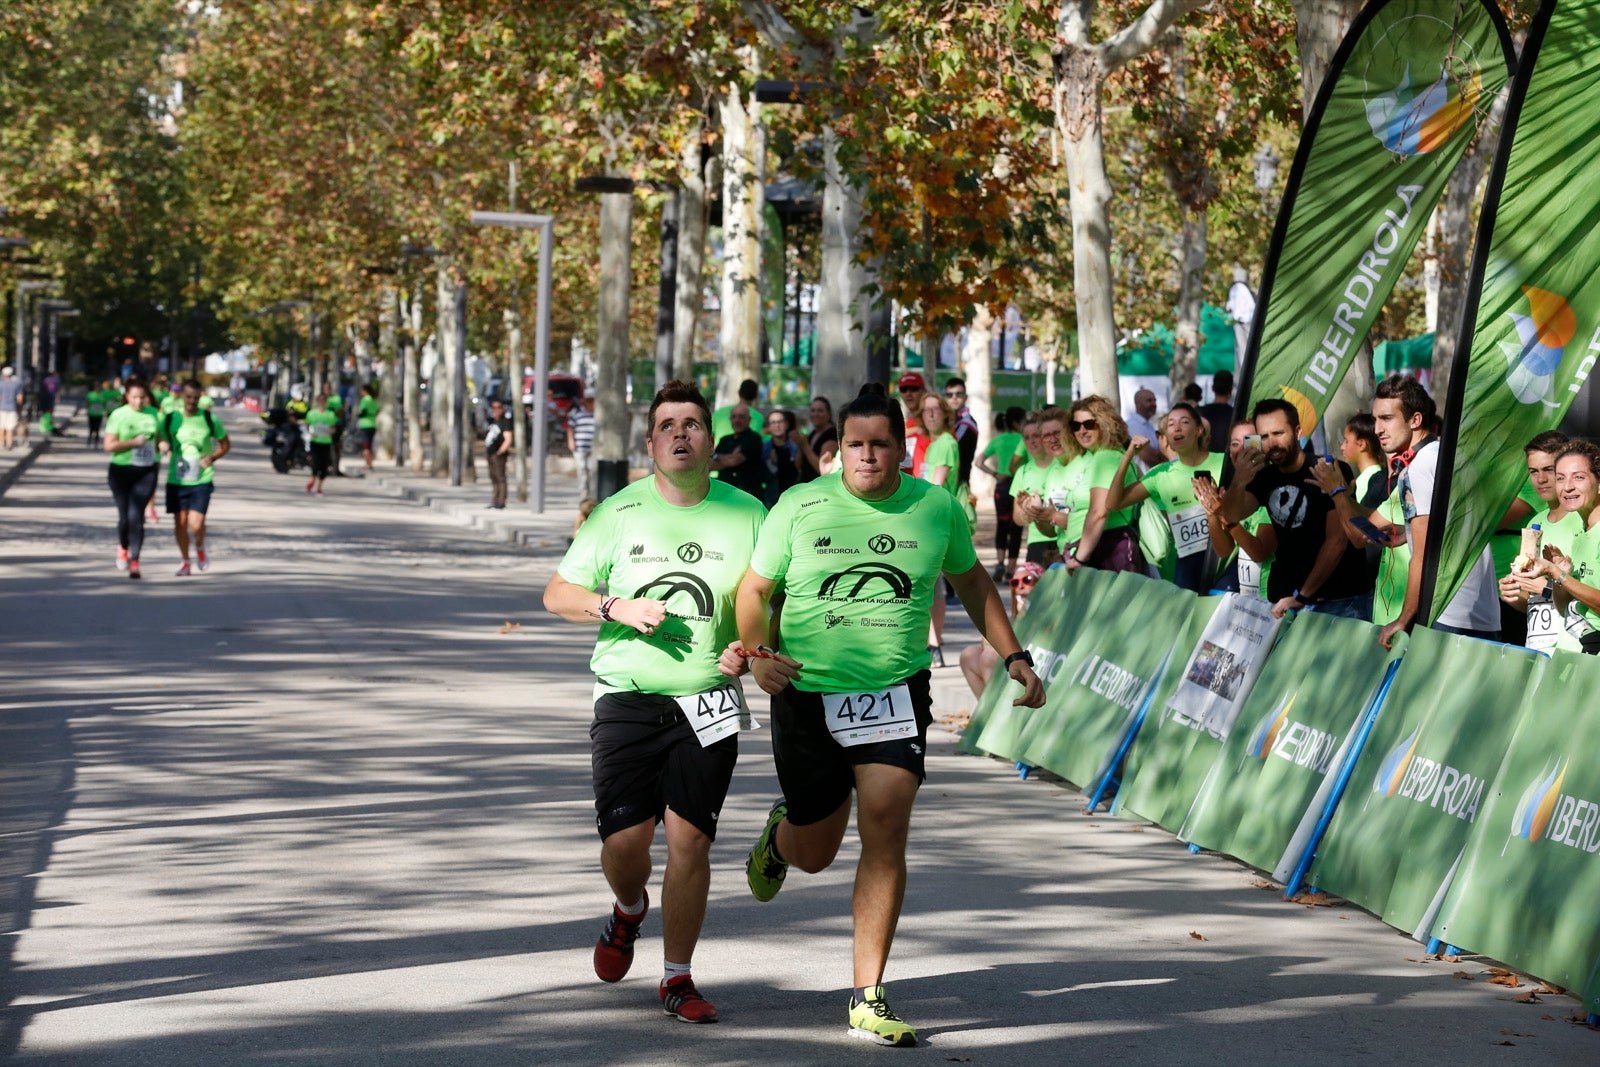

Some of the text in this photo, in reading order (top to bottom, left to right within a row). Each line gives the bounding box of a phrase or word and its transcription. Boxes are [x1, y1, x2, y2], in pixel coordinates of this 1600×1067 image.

[1303, 183, 1424, 395] IBERDROLA
[1180, 518, 1209, 542] 648
[631, 556, 669, 564] IBERDROLA
[697, 683, 742, 718] 420
[837, 691, 895, 723] 421
